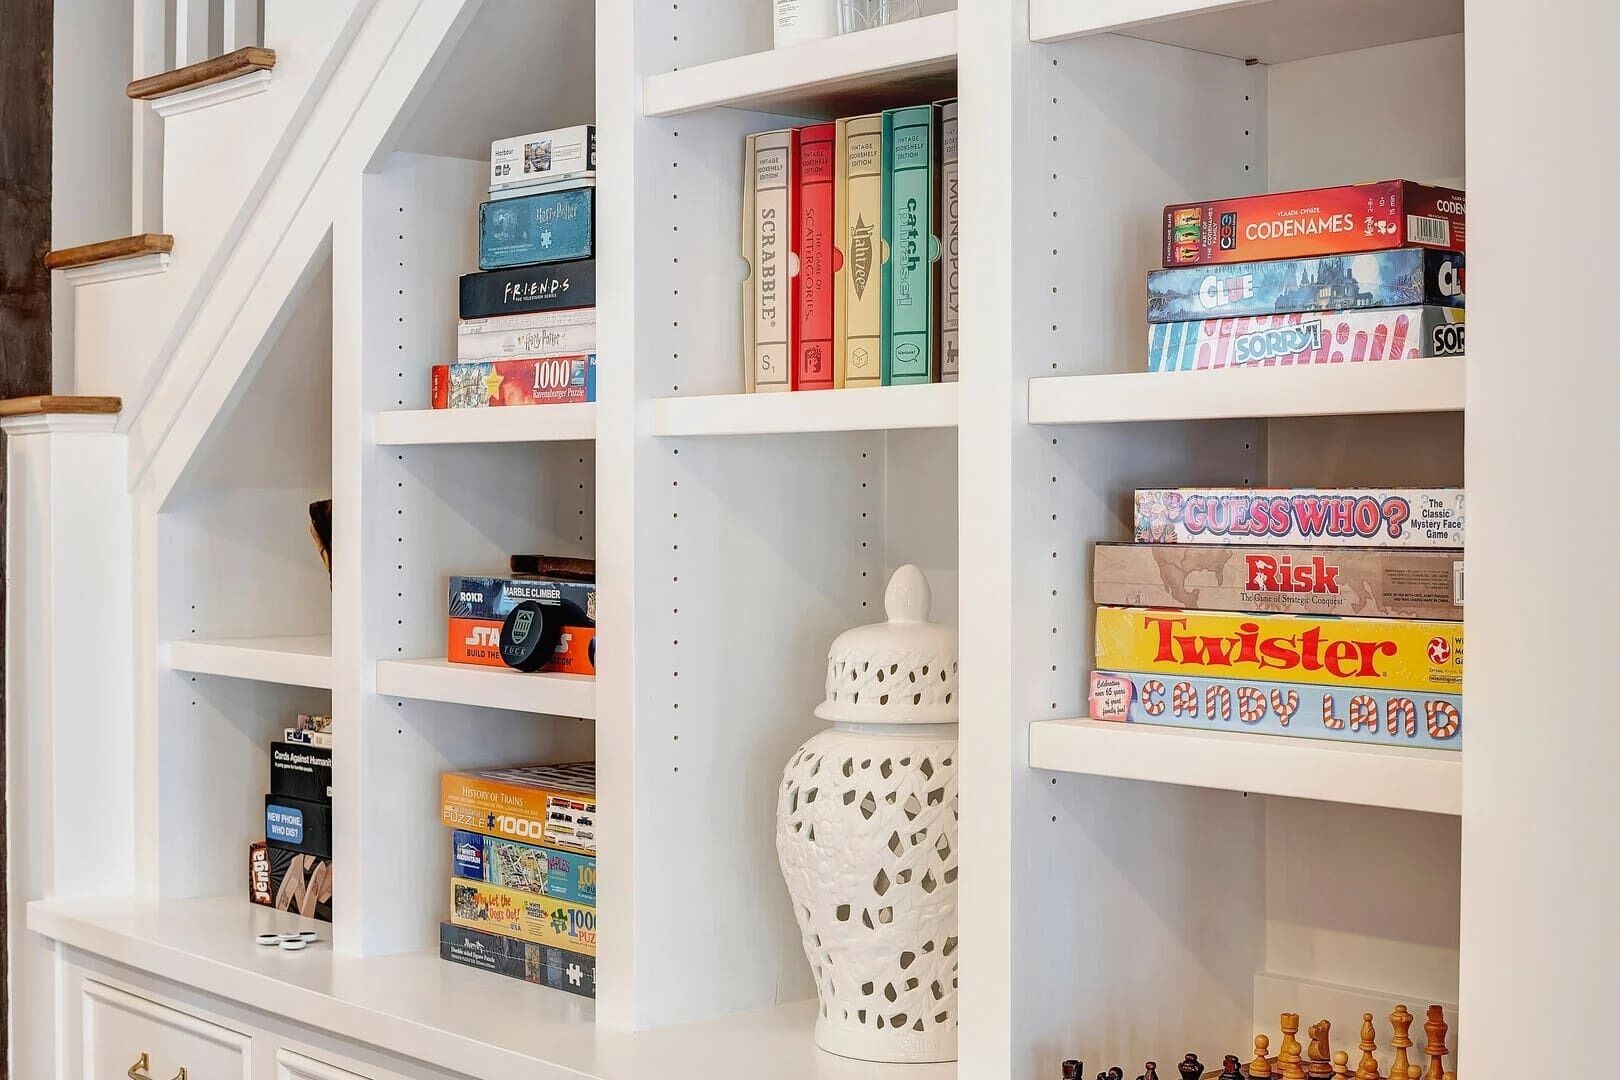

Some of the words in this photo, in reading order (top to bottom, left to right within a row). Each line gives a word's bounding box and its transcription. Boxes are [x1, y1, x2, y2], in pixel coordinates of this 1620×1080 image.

[897, 135, 920, 143] VINTAGE
[851, 159, 872, 167] EDITION
[897, 152, 919, 160] EDITION
[759, 173, 779, 181] EDITION
[535, 206, 556, 225] Harry
[556, 202, 578, 222] Potter
[1436, 199, 1466, 214] CODEN
[906, 197, 921, 272] catch
[1245, 213, 1354, 241] CODENAMES
[815, 232, 823, 247] THE
[804, 207, 815, 320] SCATTERGORIES
[815, 251, 823, 277] GAME
[850, 223, 875, 290] Yahtzee
[1438, 261, 1465, 297] CL
[1199, 274, 1254, 310] CLUE
[525, 333, 541, 351] Harry
[541, 329, 561, 350] Potter
[1236, 320, 1321, 363] SORRY!
[1433, 323, 1465, 355] SOR
[533, 359, 570, 389] 1000
[532, 388, 567, 399] Ravensburger
[567, 386, 585, 398] Puzzle
[1428, 499, 1443, 508] The
[1183, 495, 1293, 537] GUESS
[1291, 495, 1410, 539] WHO?
[1421, 509, 1450, 518] Classic
[1410, 519, 1442, 530] Mystery
[1443, 519, 1462, 529] Face
[1426, 530, 1449, 539] Game
[1244, 553, 1339, 595] Risk
[460, 591, 483, 603] ROKR
[503, 586, 531, 598] MARBLE
[531, 588, 561, 599] CLIMBER
[1240, 593, 1253, 602] The
[1254, 593, 1273, 602] Game
[1273, 593, 1281, 603] of
[1282, 594, 1310, 606] Strategic
[1311, 597, 1343, 608] Conquest
[466, 627, 500, 647] STA
[466, 649, 486, 659] BUILD
[487, 651, 500, 660] THE
[504, 645, 527, 656] TUCK
[1144, 616, 1398, 679] Twister
[1096, 679, 1121, 689] Celebrating
[1105, 687, 1112, 696] 65
[1113, 689, 1126, 697] years
[1110, 698, 1122, 706] great
[1142, 679, 1299, 727] CANDY
[1322, 693, 1460, 739] LAND
[1102, 707, 1116, 716] family
[1116, 705, 1126, 715] fun!
[274, 750, 290, 761] Cards
[290, 753, 309, 764] Against
[309, 755, 332, 767] Humanit
[462, 786, 489, 800] HISTORY
[489, 792, 499, 801] OF
[500, 793, 524, 807] TRAINS
[267, 812, 280, 824] NEW
[280, 813, 302, 827] PHONE,
[442, 810, 485, 828] PUZZLE
[496, 814, 542, 839] 1000
[271, 824, 285, 836] WHO
[285, 826, 299, 838] DIS?
[456, 854, 481, 864] MOUNTAIN
[461, 847, 476, 857] WHITE
[547, 856, 570, 873] NAPLES
[251, 850, 270, 904] Jenga
[474, 893, 488, 905] Who
[488, 894, 499, 907] Let
[500, 894, 511, 907] the
[489, 908, 505, 921] Dogs
[505, 908, 520, 922] Out!
[526, 906, 544, 914] MOUNTAIN
[510, 922, 522, 932] USA
[567, 908, 596, 938] 100
[578, 930, 596, 944] PUZ
